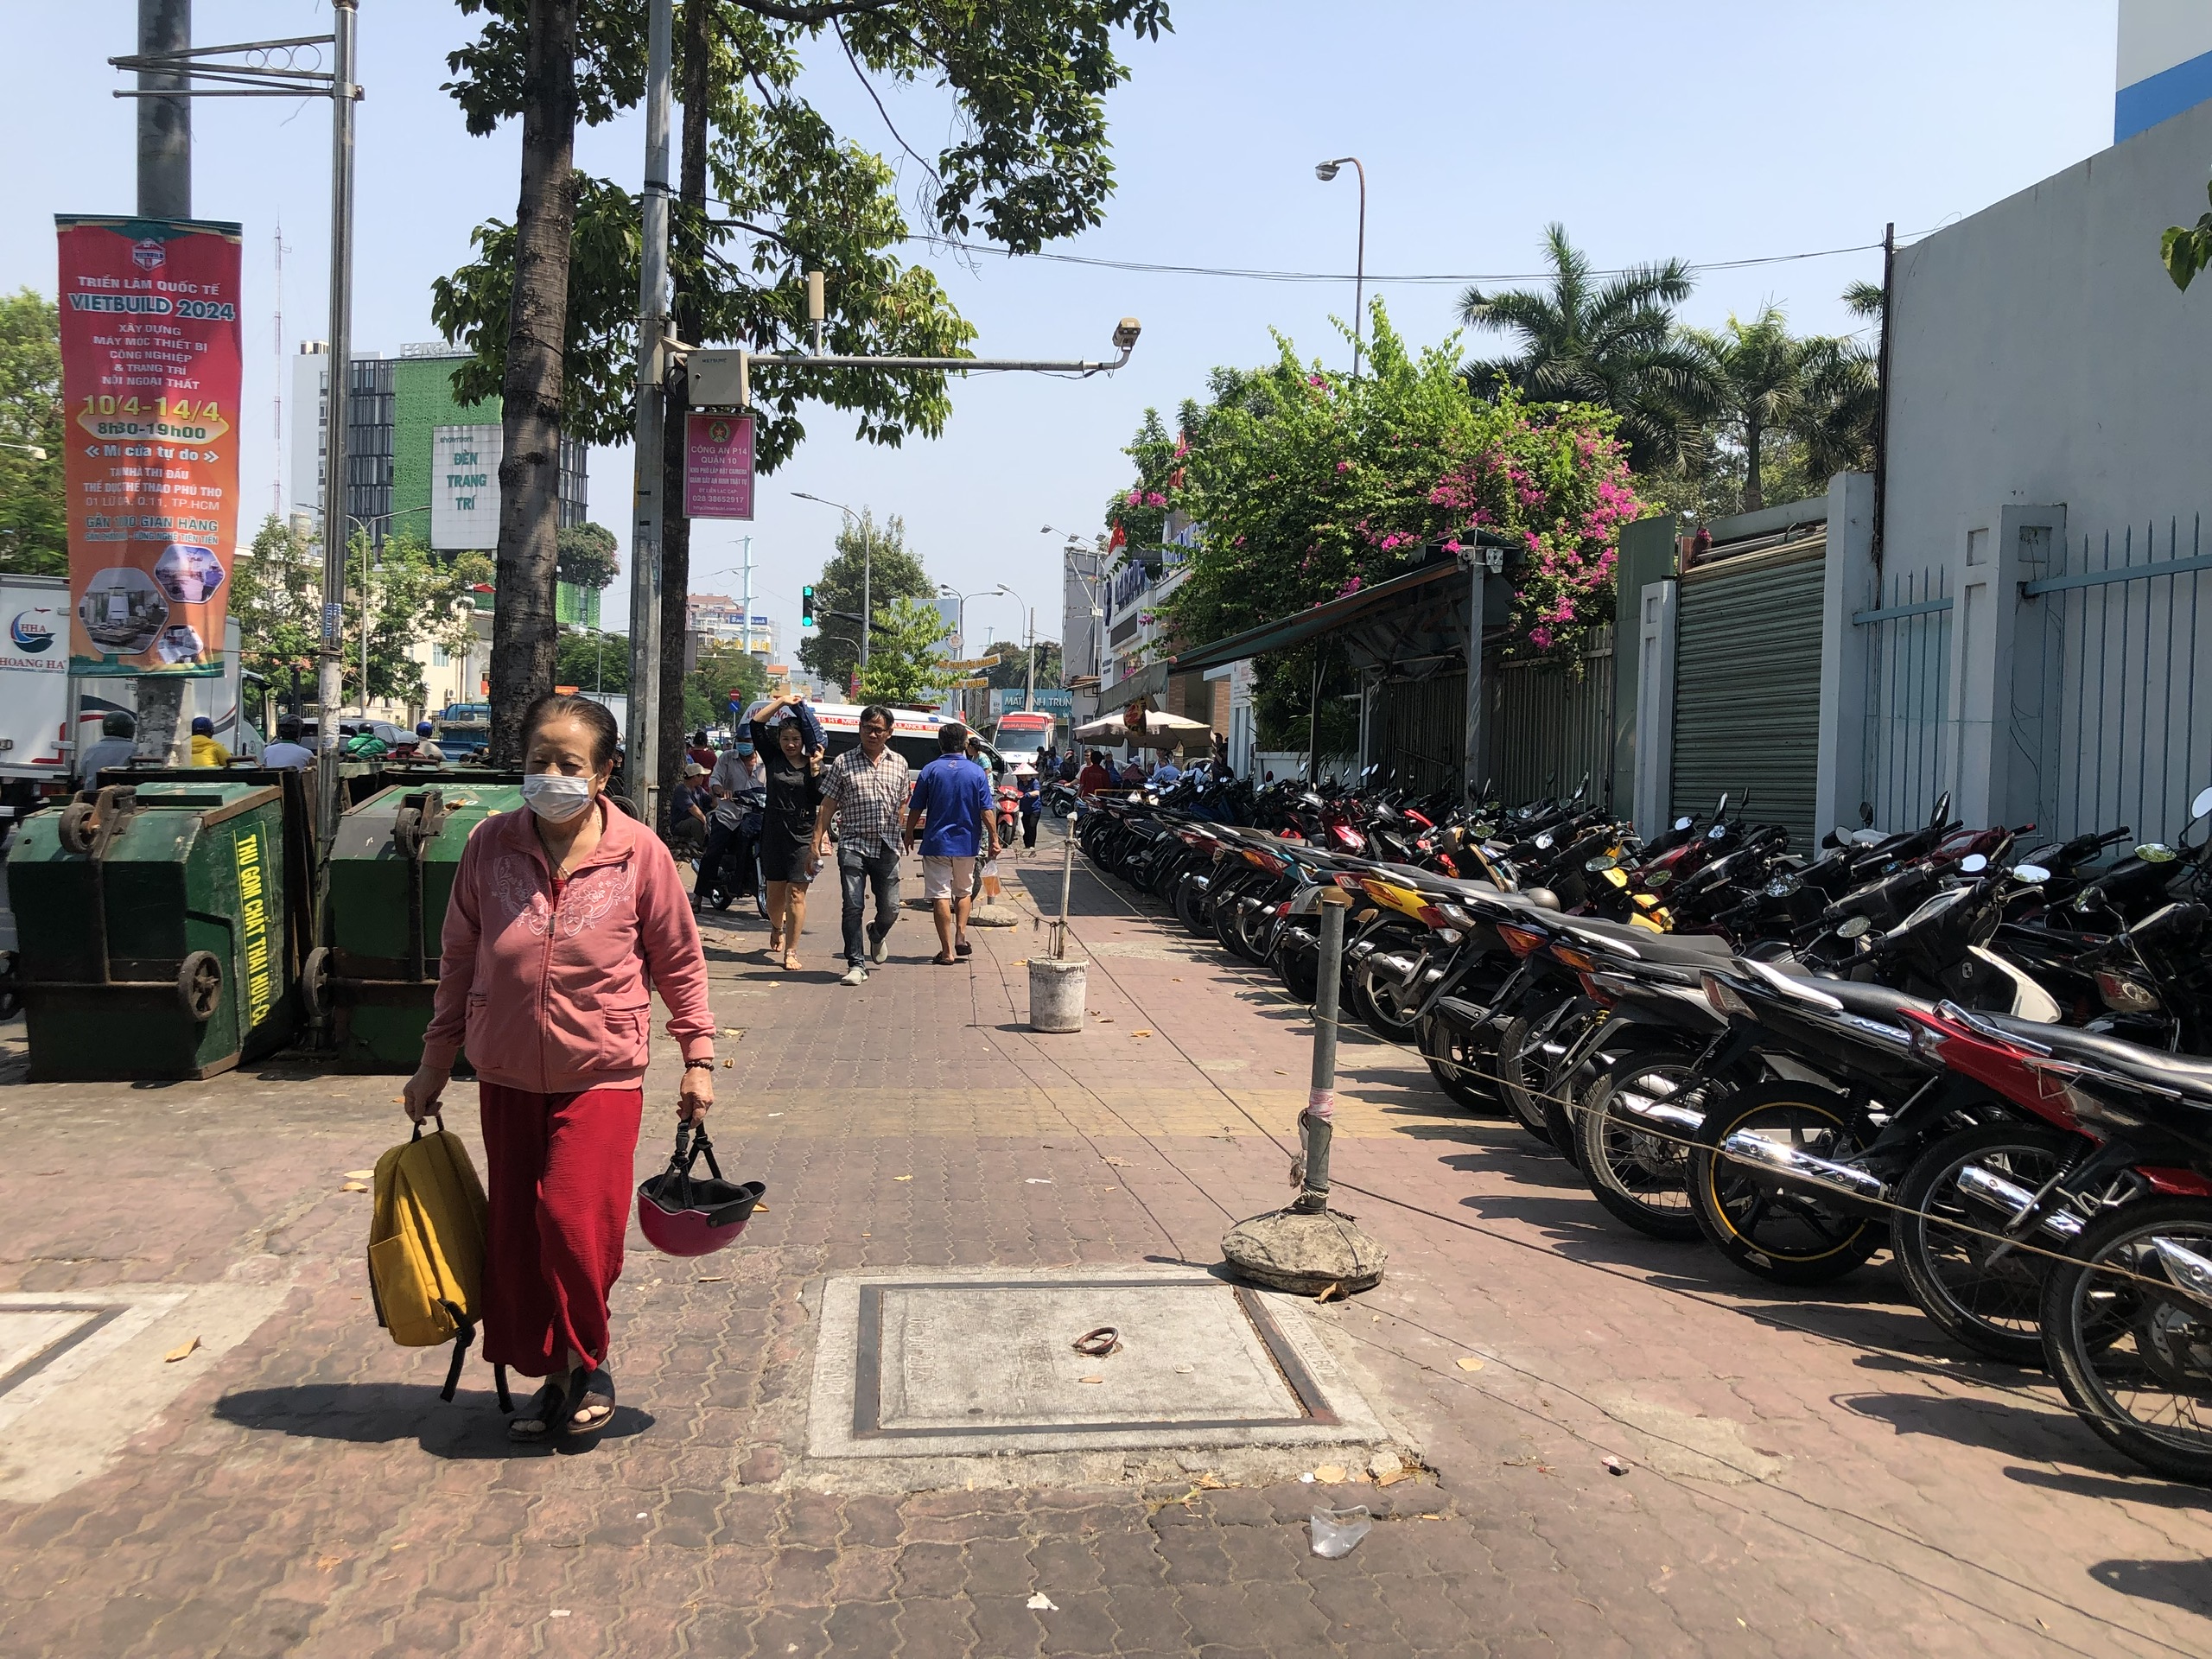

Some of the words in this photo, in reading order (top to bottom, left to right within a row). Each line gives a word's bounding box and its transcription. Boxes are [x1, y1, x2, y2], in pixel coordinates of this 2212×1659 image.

[156, 280, 197, 294] QUỐC
[201, 283, 221, 295] TẾ
[68, 293, 173, 315] VIETBUILD
[175, 298, 236, 321] 2024
[154, 338, 192, 350] THIẾT
[194, 342, 207, 353] BỊ
[110, 350, 142, 359] CÔNG
[144, 351, 193, 363] NGHIỆP
[126, 364, 163, 372] TRANG
[167, 364, 187, 376] TRÍ
[166, 378, 200, 390] THẤT
[156, 446, 175, 461] tự
[179, 448, 199, 461] do
[454, 449, 478, 465] ĐÈN
[691, 445, 715, 454] CÔNG
[701, 455, 725, 465] QUẬN
[144, 467, 162, 478] THI
[166, 467, 188, 480] ĐẤU
[447, 474, 487, 487] TRANG
[143, 482, 171, 493] THAO
[174, 483, 197, 496] PHÚ
[200, 486, 223, 499] THỌ
[171, 498, 220, 511] TP.HCM
[455, 494, 477, 510] TRÍ
[141, 515, 173, 529] GIAN
[178, 515, 219, 531] HÀNG
[21, 624, 47, 632] HHA
[0, 657, 43, 668] HOANG
[46, 659, 65, 669] HA
[238, 834, 258, 865] THU
[241, 866, 263, 899] GOM
[244, 899, 271, 938] CHẤT
